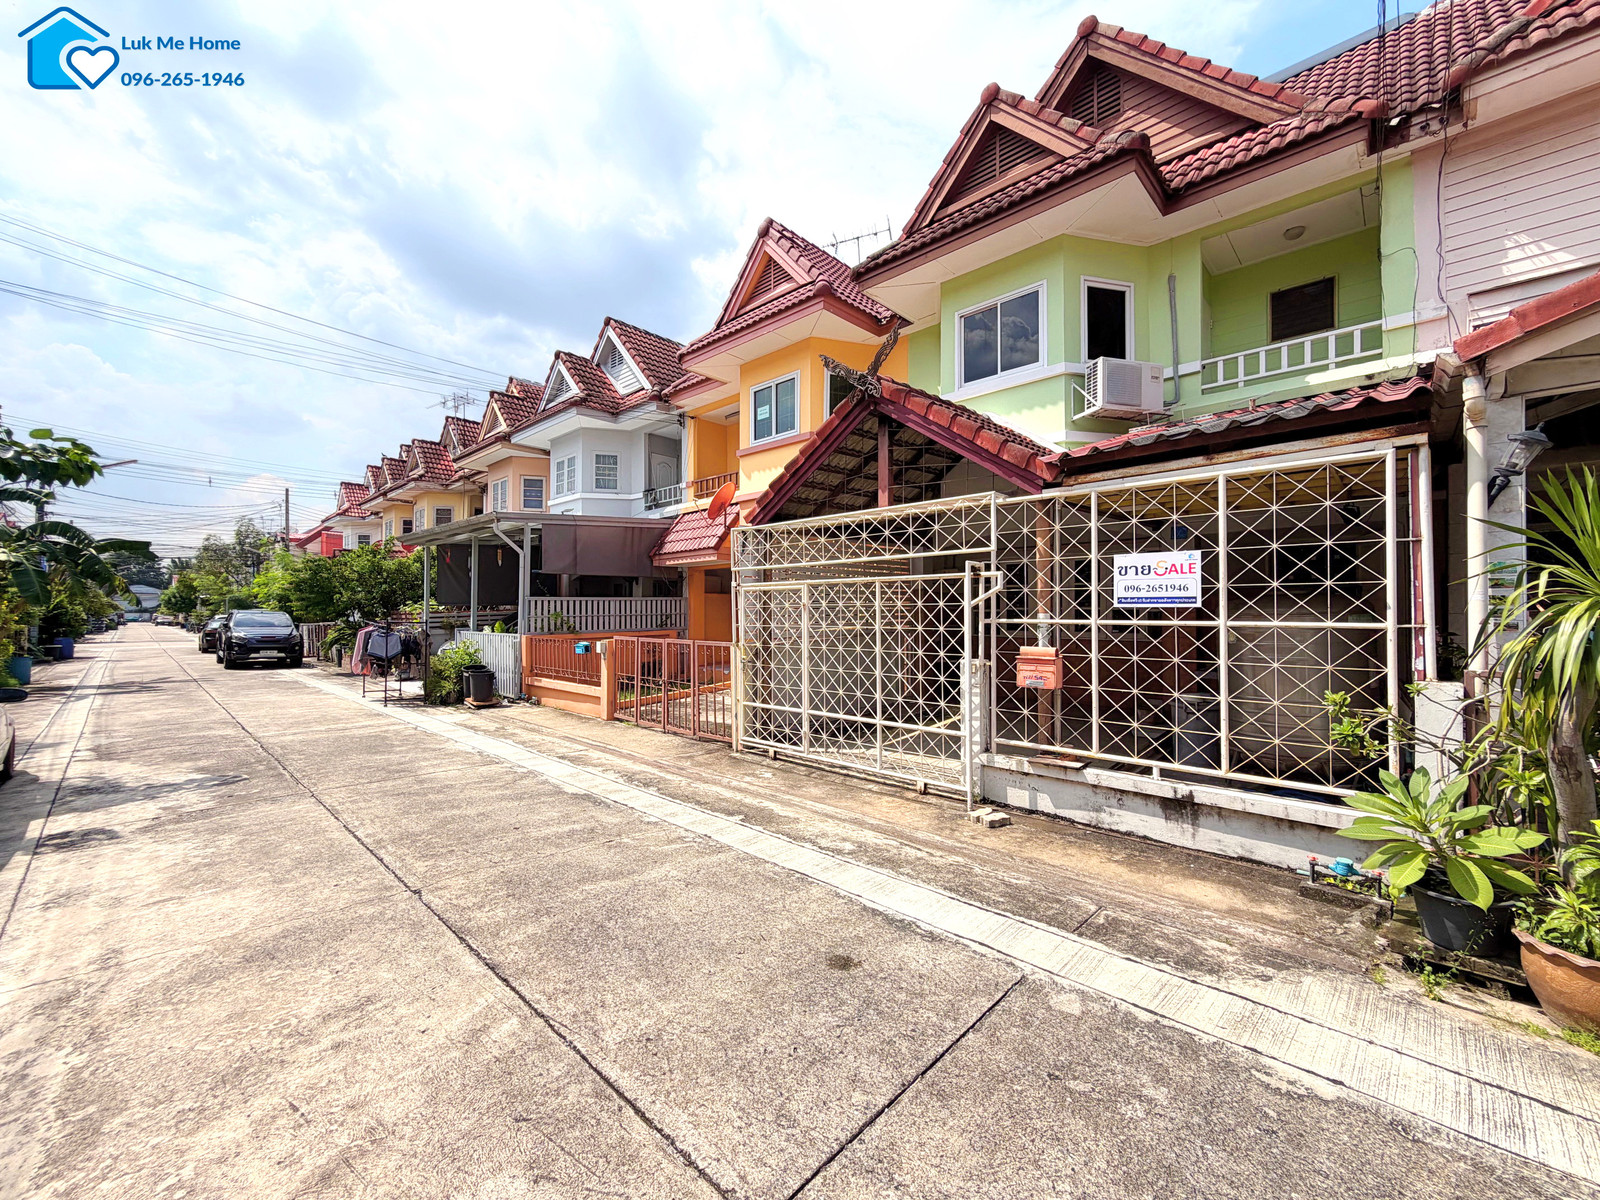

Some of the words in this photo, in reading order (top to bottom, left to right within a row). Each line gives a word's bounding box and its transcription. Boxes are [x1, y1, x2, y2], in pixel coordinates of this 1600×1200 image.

[1117, 564, 1151, 577] ขาย
[1153, 560, 1197, 577] SALE
[1123, 583, 1189, 593] 096-2651946
